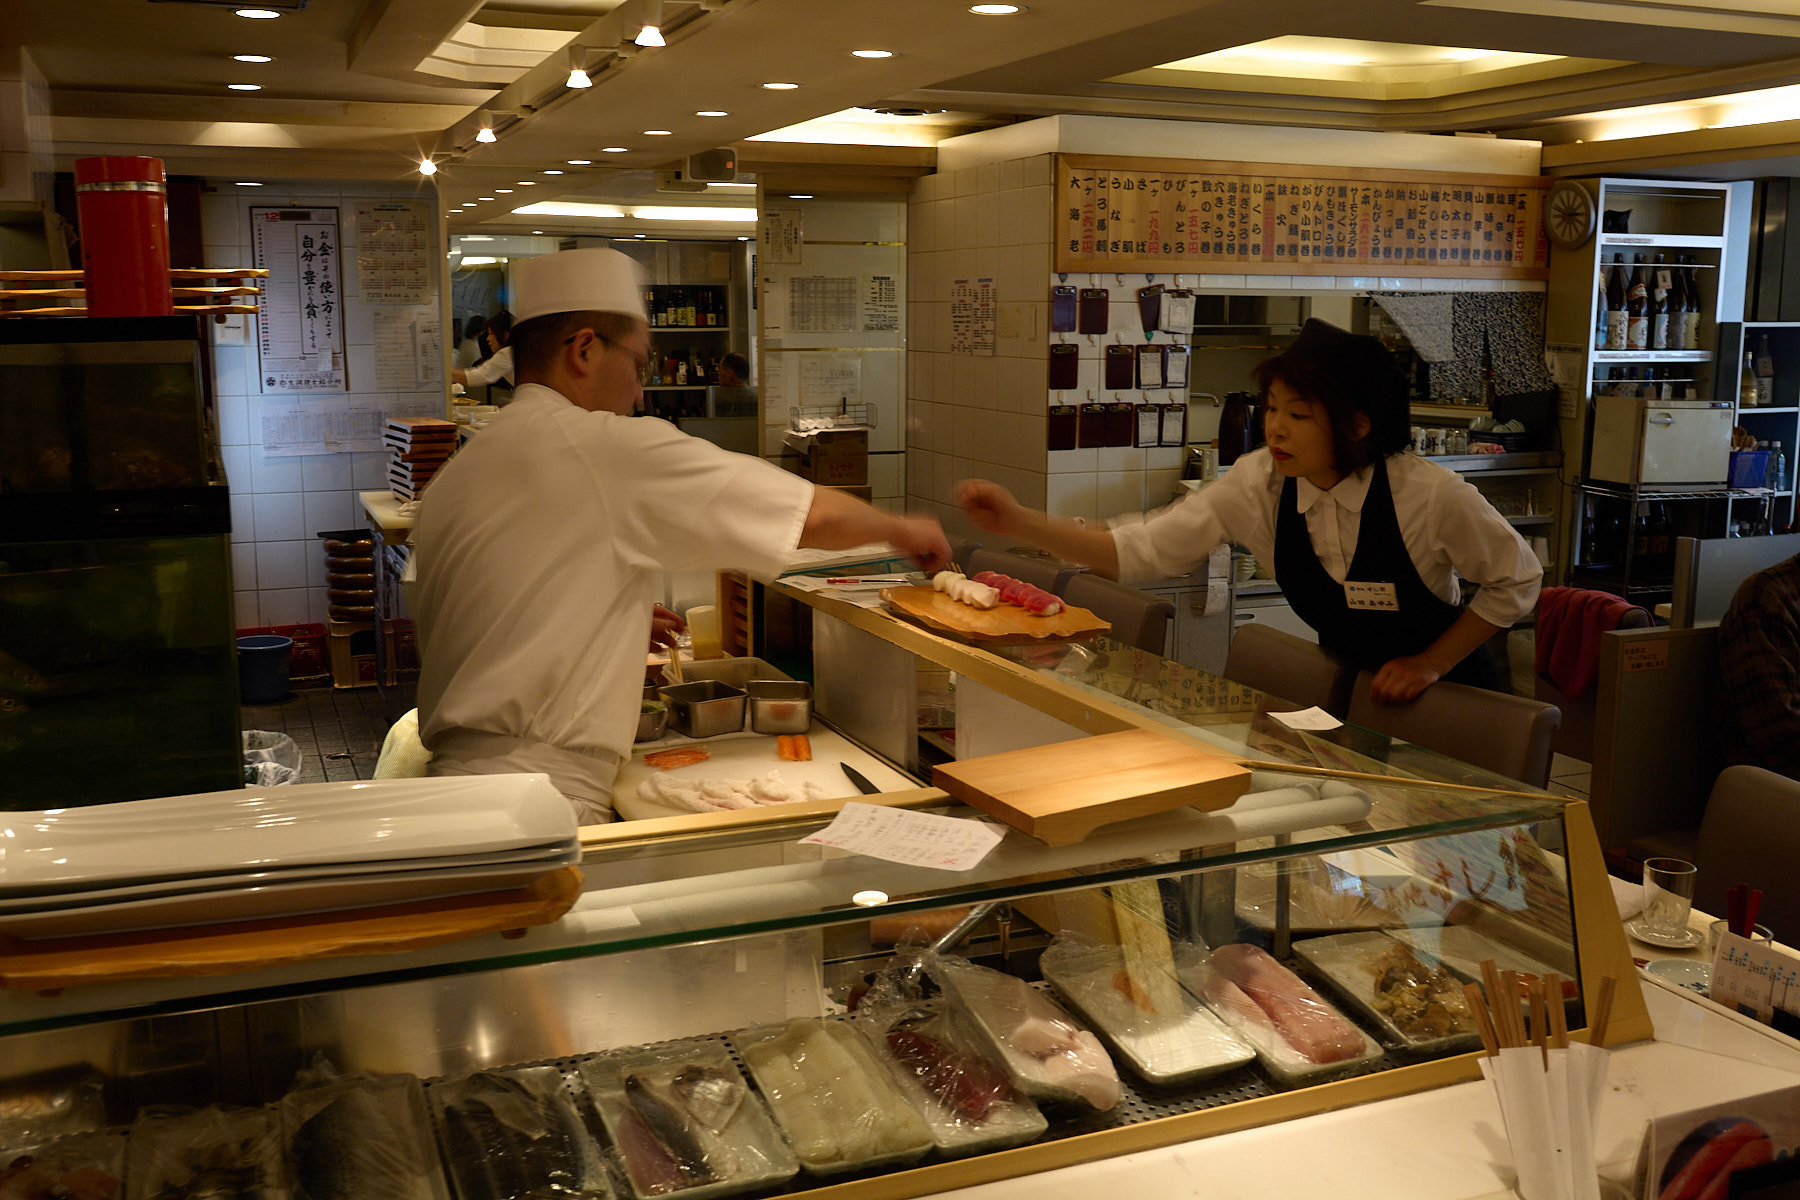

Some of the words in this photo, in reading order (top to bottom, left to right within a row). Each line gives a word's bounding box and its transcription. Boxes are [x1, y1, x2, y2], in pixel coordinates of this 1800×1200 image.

[264, 212, 279, 220] 12
[1096, 177, 1107, 252] とろ馬刺
[1110, 178, 1121, 252] うなぎ
[1136, 179, 1147, 253] さば
[1163, 180, 1172, 254] ひも
[1175, 180, 1187, 254] びんとろ
[1188, 210, 1198, 254] 一五七円
[1201, 181, 1212, 254] 数の子巻
[1213, 182, 1225, 254] 穴きゅう巻
[1226, 182, 1238, 255] 海老きゅう巻
[1239, 182, 1250, 256] ねぎとろ巻
[1251, 183, 1262, 256] いくら巻
[1276, 184, 1287, 256] 鉄火巻
[1312, 185, 1324, 257] びんトロ巻
[1324, 186, 1335, 257] ひもきゅう巻
[1347, 187, 1358, 258] サーモンサラダ巻
[1361, 188, 1371, 205] 一本
[1394, 189, 1406, 259] 納豆巻
[1417, 190, 1428, 259] 山ごぼう巻
[1428, 190, 1440, 260] 梅しそ巻
[1439, 190, 1451, 260] たらこ巻
[1450, 191, 1463, 260] 明太子巻
[1472, 192, 1484, 261] 山芋巻
[1149, 211, 1159, 254] 一九九円
